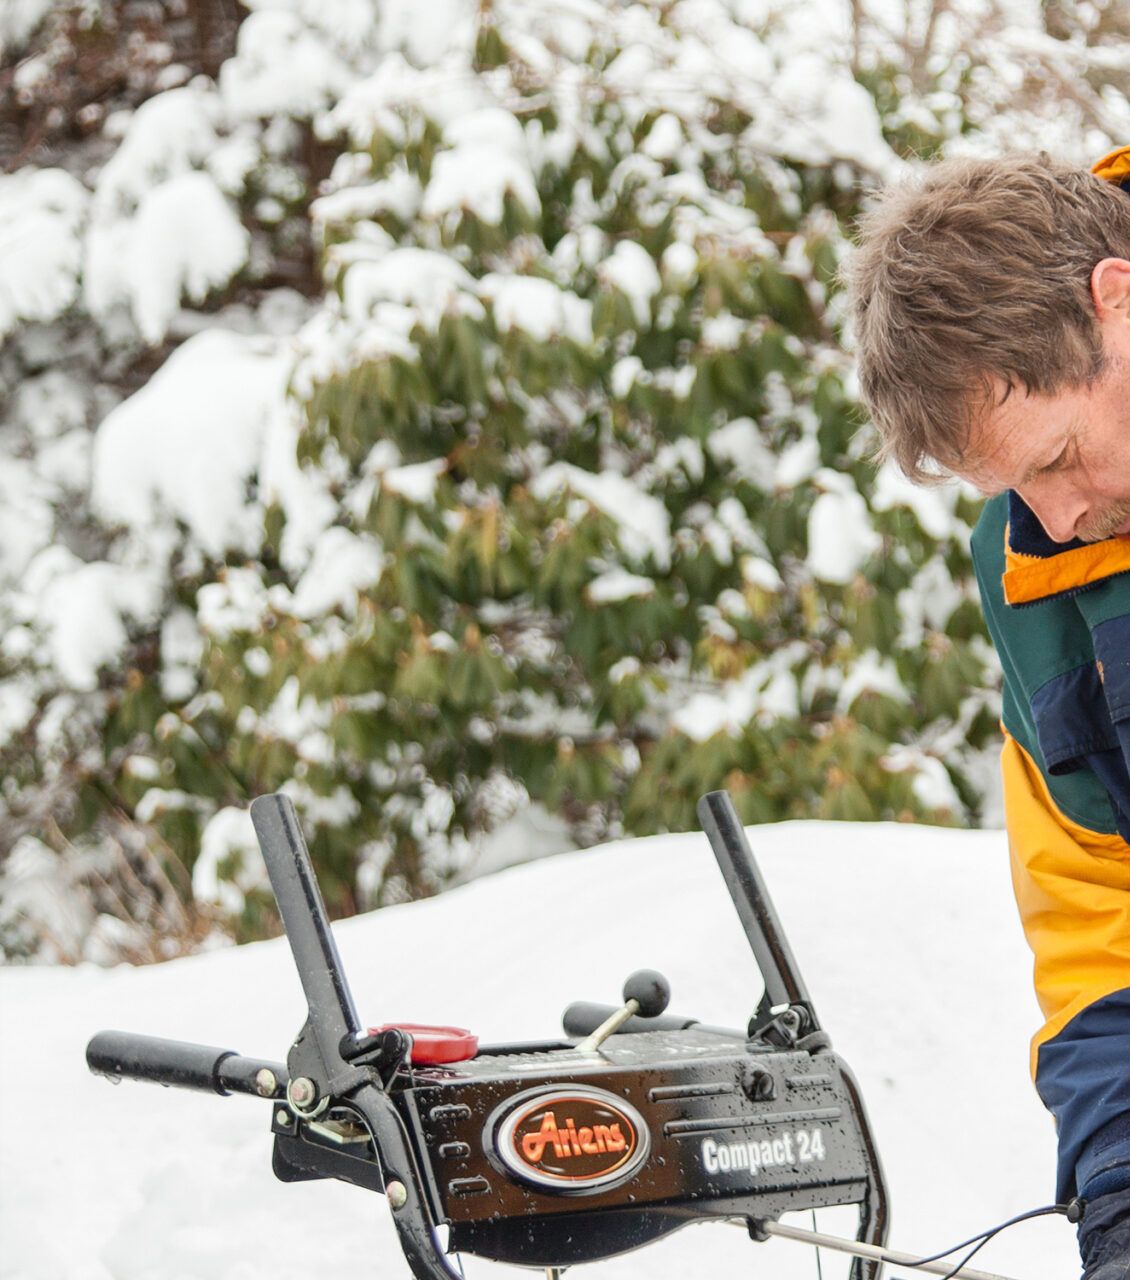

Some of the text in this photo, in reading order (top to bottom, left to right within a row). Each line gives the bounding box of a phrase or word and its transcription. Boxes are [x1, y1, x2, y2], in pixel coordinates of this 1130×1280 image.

[521, 1111, 626, 1162] Ariens
[702, 1127, 826, 1176] Compact 24
